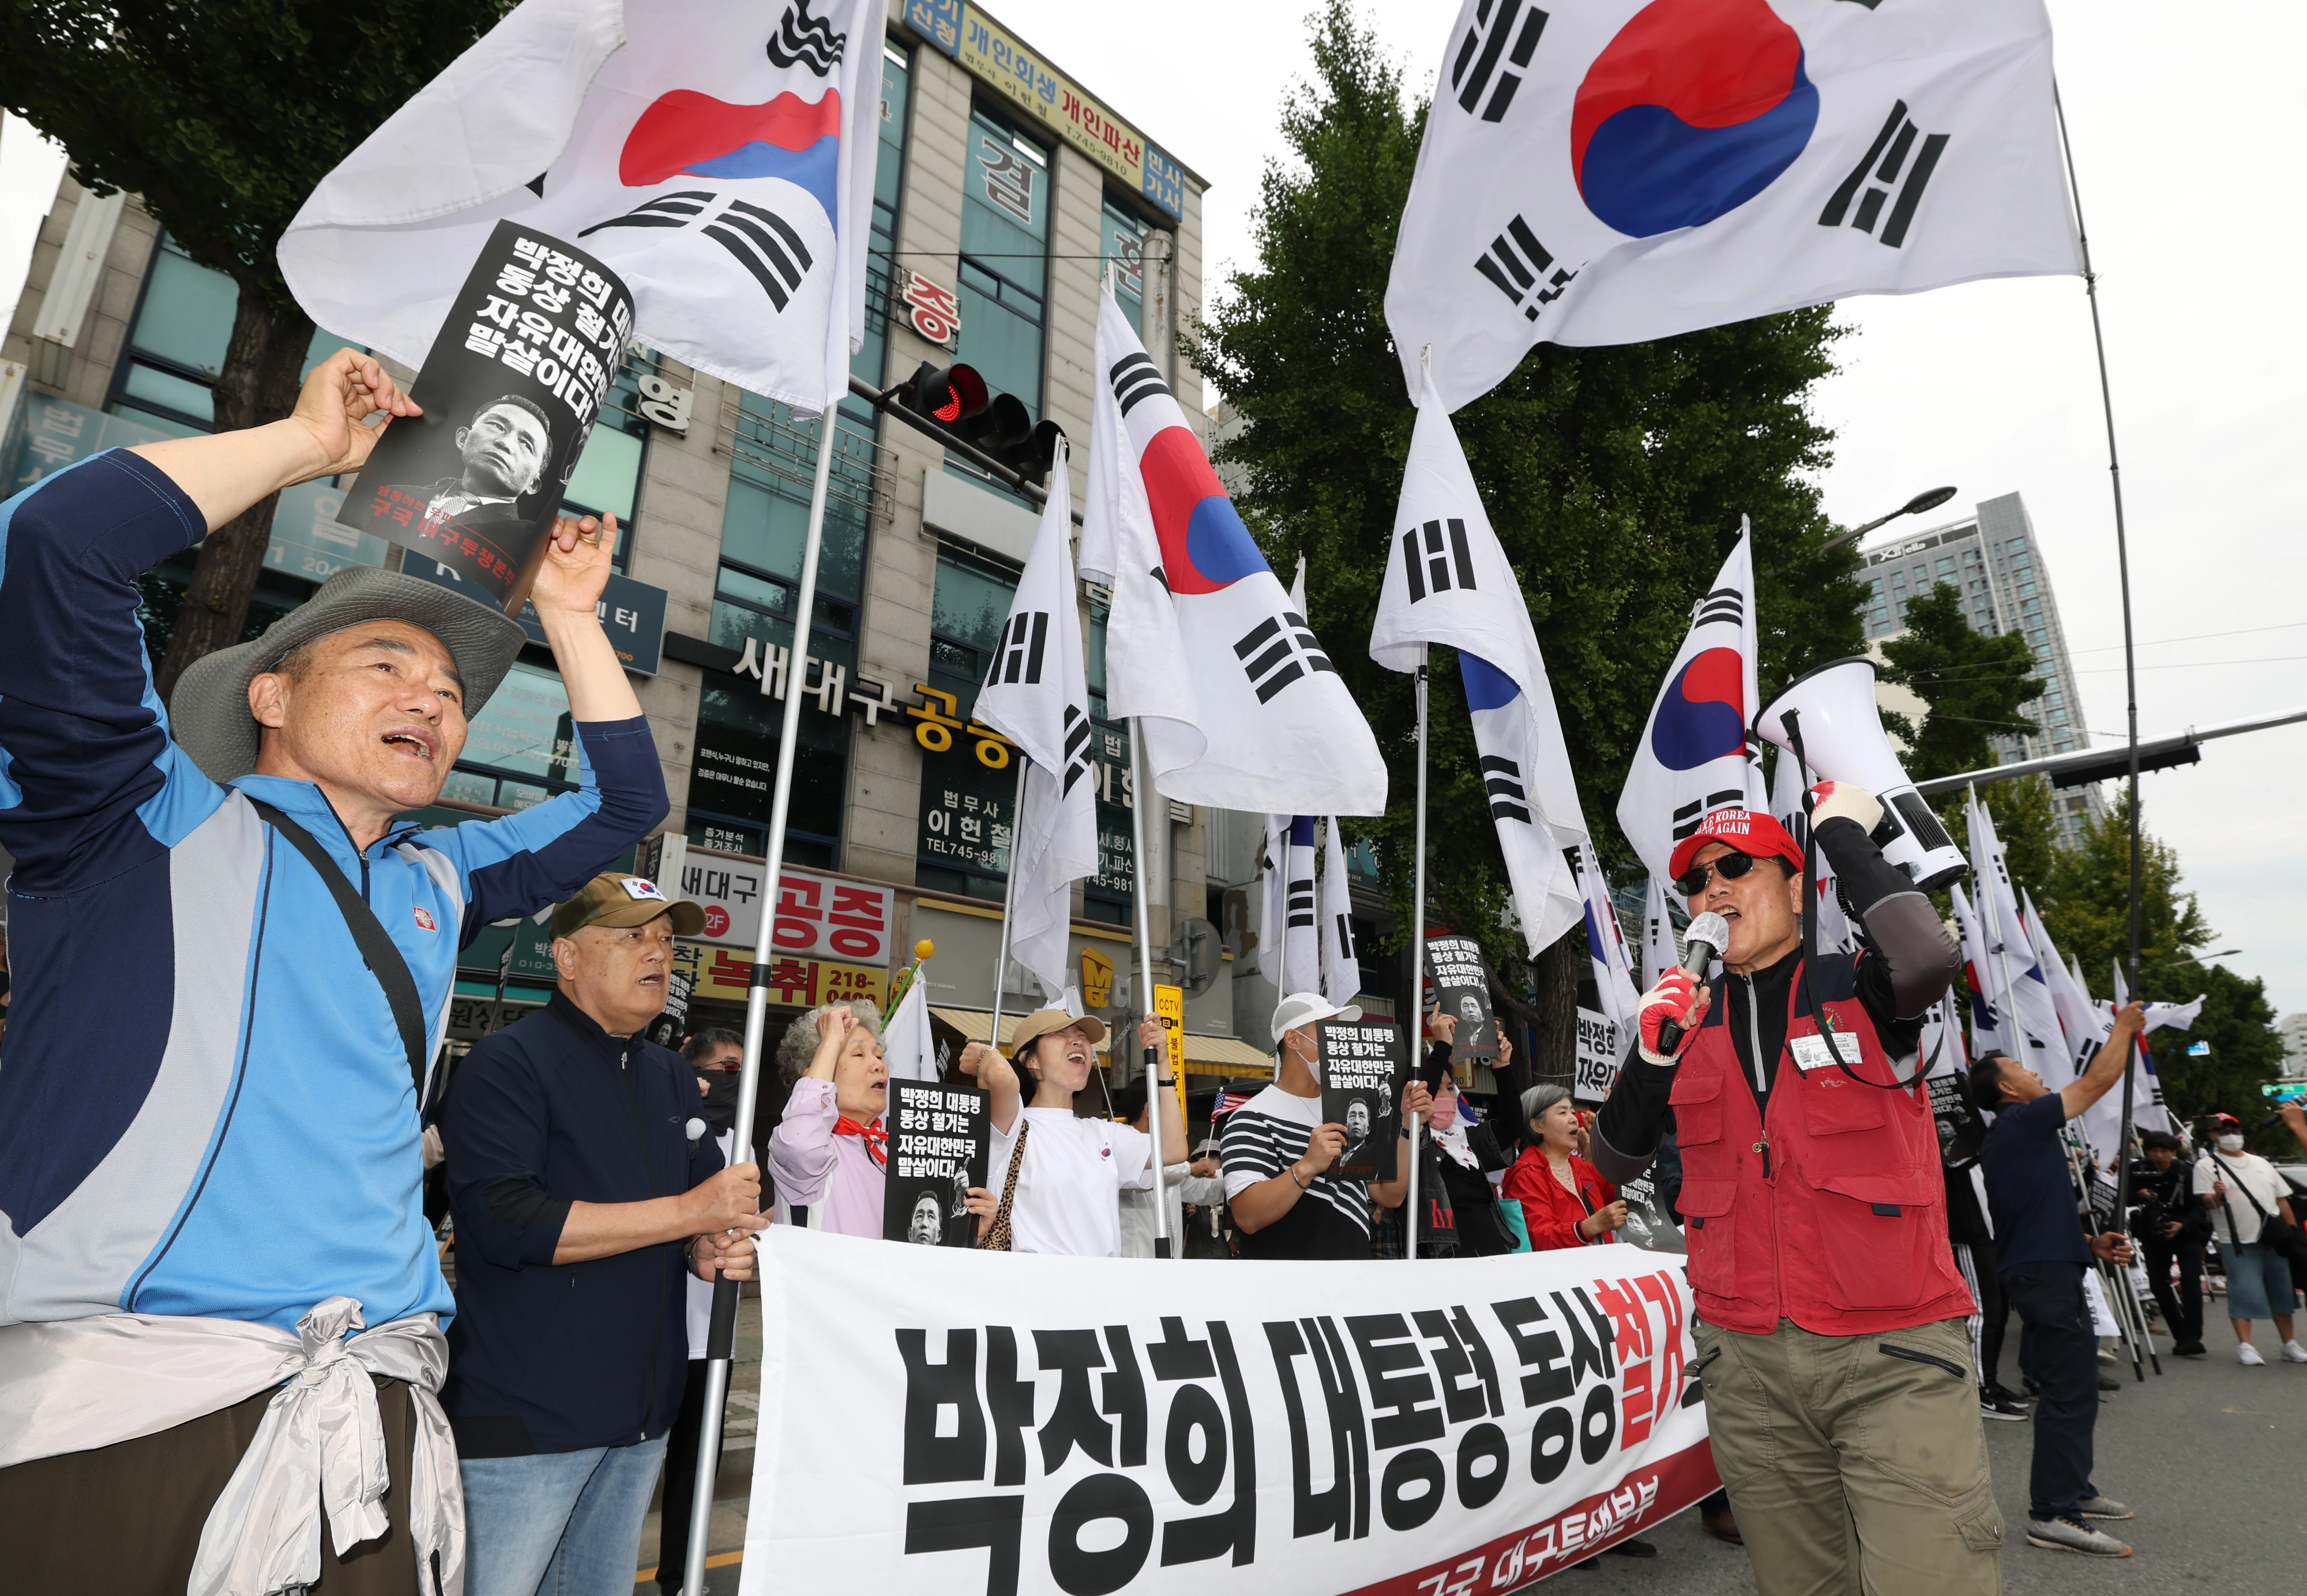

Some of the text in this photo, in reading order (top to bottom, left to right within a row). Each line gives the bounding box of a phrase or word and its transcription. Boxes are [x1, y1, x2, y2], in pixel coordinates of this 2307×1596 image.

[911, 2, 956, 47] 신청
[965, 51, 997, 81] 법무사
[968, 18, 1056, 105] 개인회생
[1062, 89, 1141, 169] 개인파산
[1065, 125, 1127, 176] T.745-9810
[1147, 149, 1181, 190] 민사
[1147, 179, 1181, 213] 가사
[513, 237, 613, 310] 박정희
[496, 263, 620, 382] 동상 철거
[464, 322, 594, 425] 말살이다!
[378, 485, 454, 524] 행동하는 우파
[370, 497, 414, 528] 구국
[417, 517, 516, 586] 대구투쟁본부
[735, 756, 752, 768] 말하고
[753, 760, 771, 773] 있지만,
[716, 771, 733, 784] 아무나
[944, 790, 999, 819] 법무사
[1715, 810, 1751, 823] KOREA
[1715, 821, 1750, 835] AGAIN
[705, 826, 744, 843] 증거분석
[928, 810, 1011, 849] 이헌철
[704, 838, 743, 854] 증거조사
[681, 865, 885, 958] 새대구 공증
[1427, 939, 1480, 955] 박정희 대통령
[1431, 951, 1479, 964] 동상 철거는
[670, 974, 681, 987] 정희
[709, 950, 819, 1006] 녹취
[829, 970, 875, 989] 218-
[1434, 963, 1485, 978] 자유대한민국
[1438, 975, 1480, 988] 말살이다!
[667, 995, 688, 1012] 유대한민국
[1159, 999, 1179, 1012] CCTV
[1325, 1026, 1395, 1043] 박정희 대통령
[1327, 1041, 1385, 1057] 동상 철거는
[1328, 1059, 1395, 1075] 자유대한민국
[1329, 1074, 1378, 1089] 말살이다!
[900, 1087, 980, 1115] 박정희 대통령
[900, 1109, 970, 1134] 동상 철거는
[897, 1134, 976, 1159] 자유대한민국
[897, 1157, 956, 1179] 말살이다!
[1621, 1185, 1645, 1204] 말살이다!
[895, 1316, 1256, 1596] 박정희
[1261, 1305, 1510, 1542] 대통령
[1491, 1474, 1659, 1589] 대구투쟁본부
